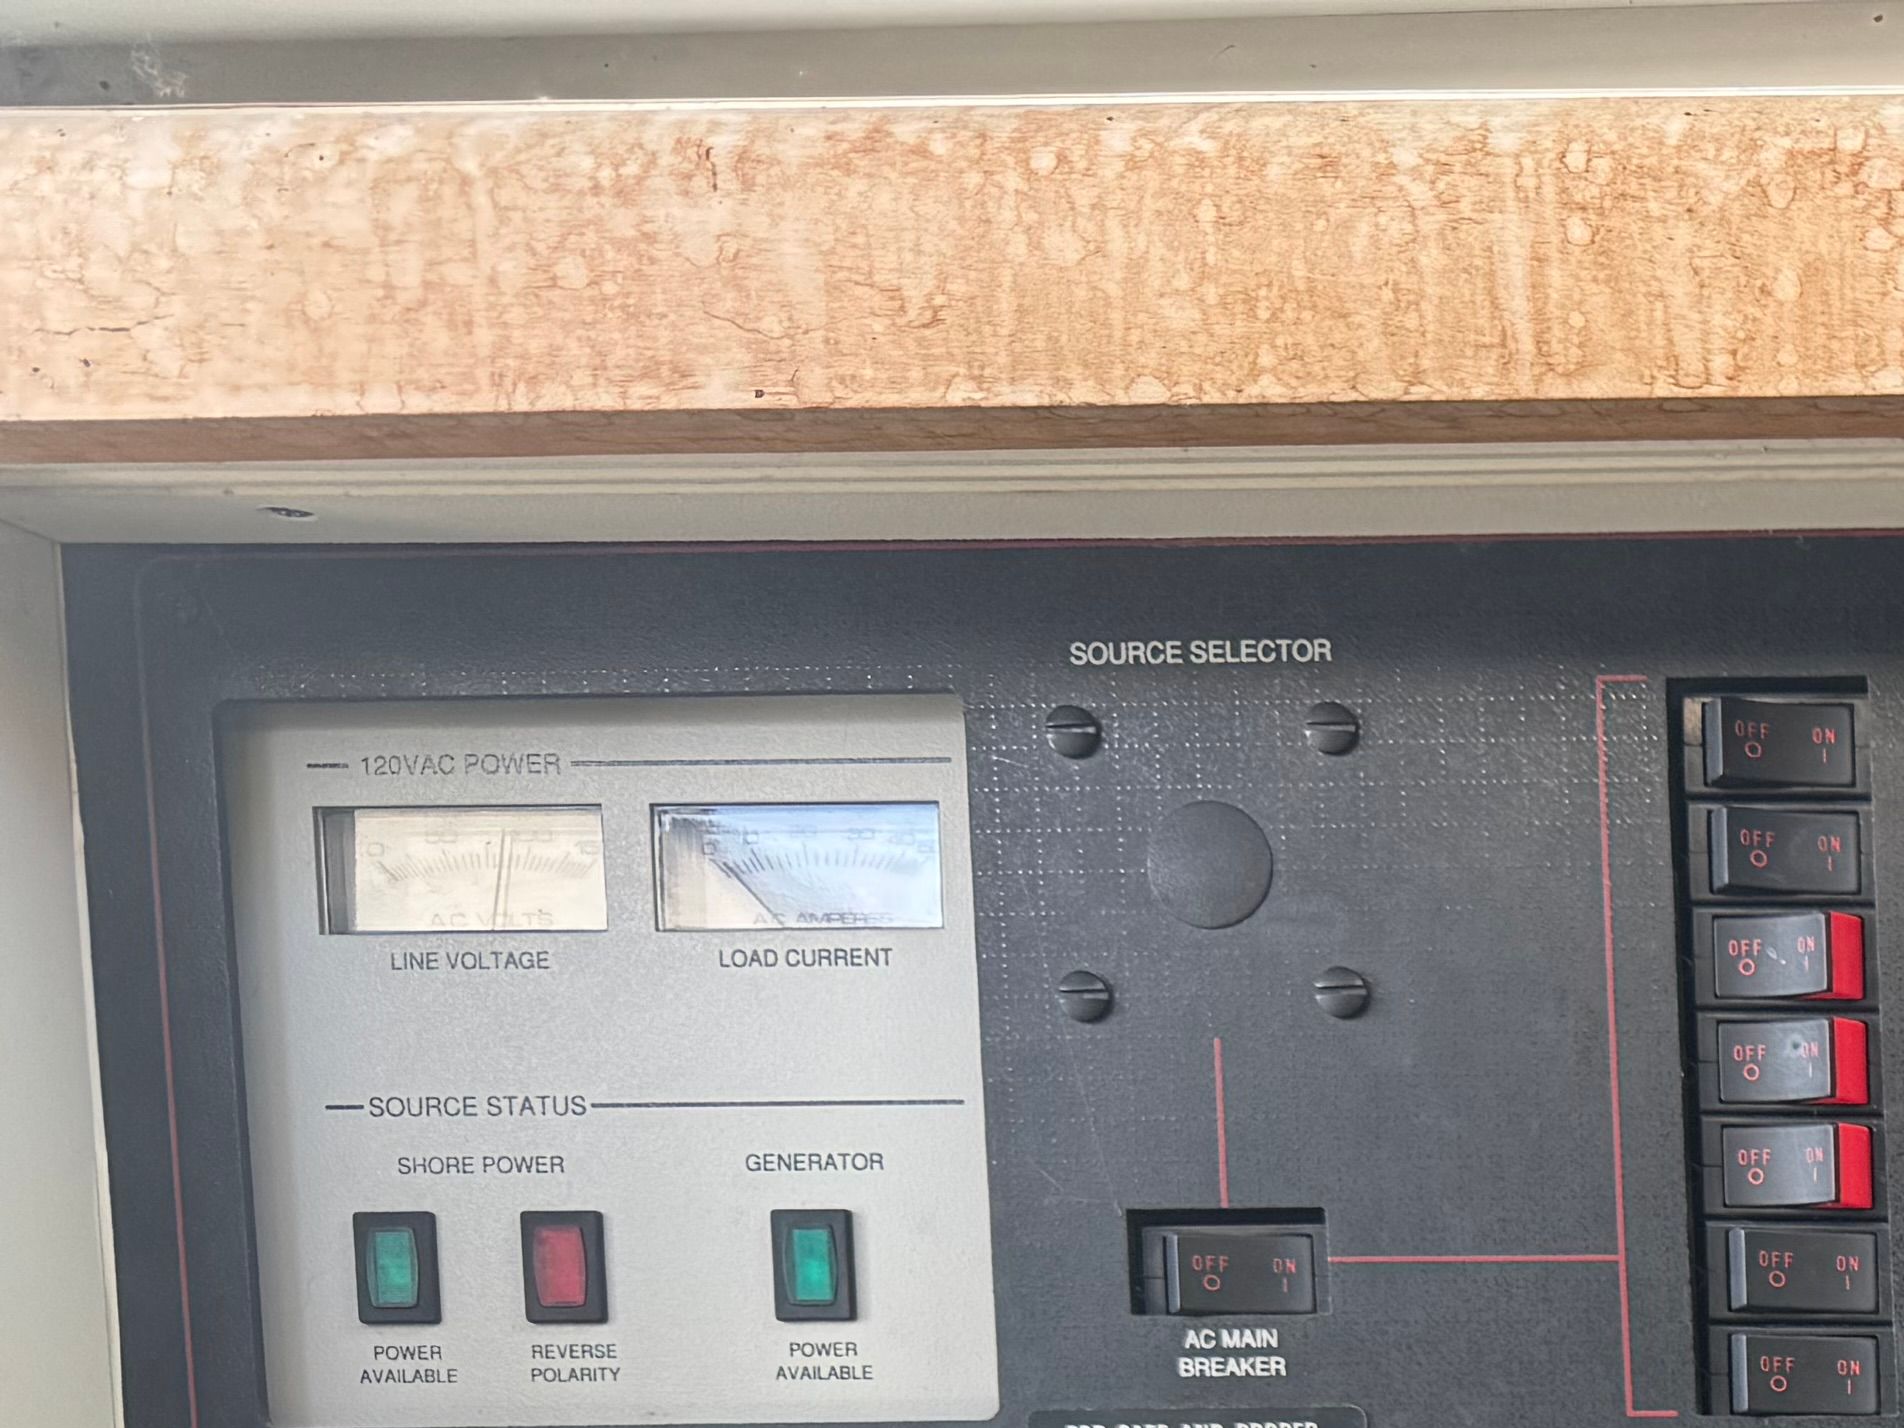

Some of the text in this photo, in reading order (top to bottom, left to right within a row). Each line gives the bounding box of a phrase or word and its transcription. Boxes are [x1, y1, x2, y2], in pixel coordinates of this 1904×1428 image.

[1069, 638, 1332, 666] SOURCE SELECTOR
[390, 950, 551, 971] LINE VOLTAGE
[397, 1155, 565, 1175] SHORE POWER
[1191, 1254, 1297, 1274] OFF ON
[1184, 1328, 1278, 1349] AC MAIN
[531, 1343, 618, 1360] REVERSE
[530, 1366, 621, 1383] POLARITY
[1178, 1356, 1287, 1378] BREAKER
